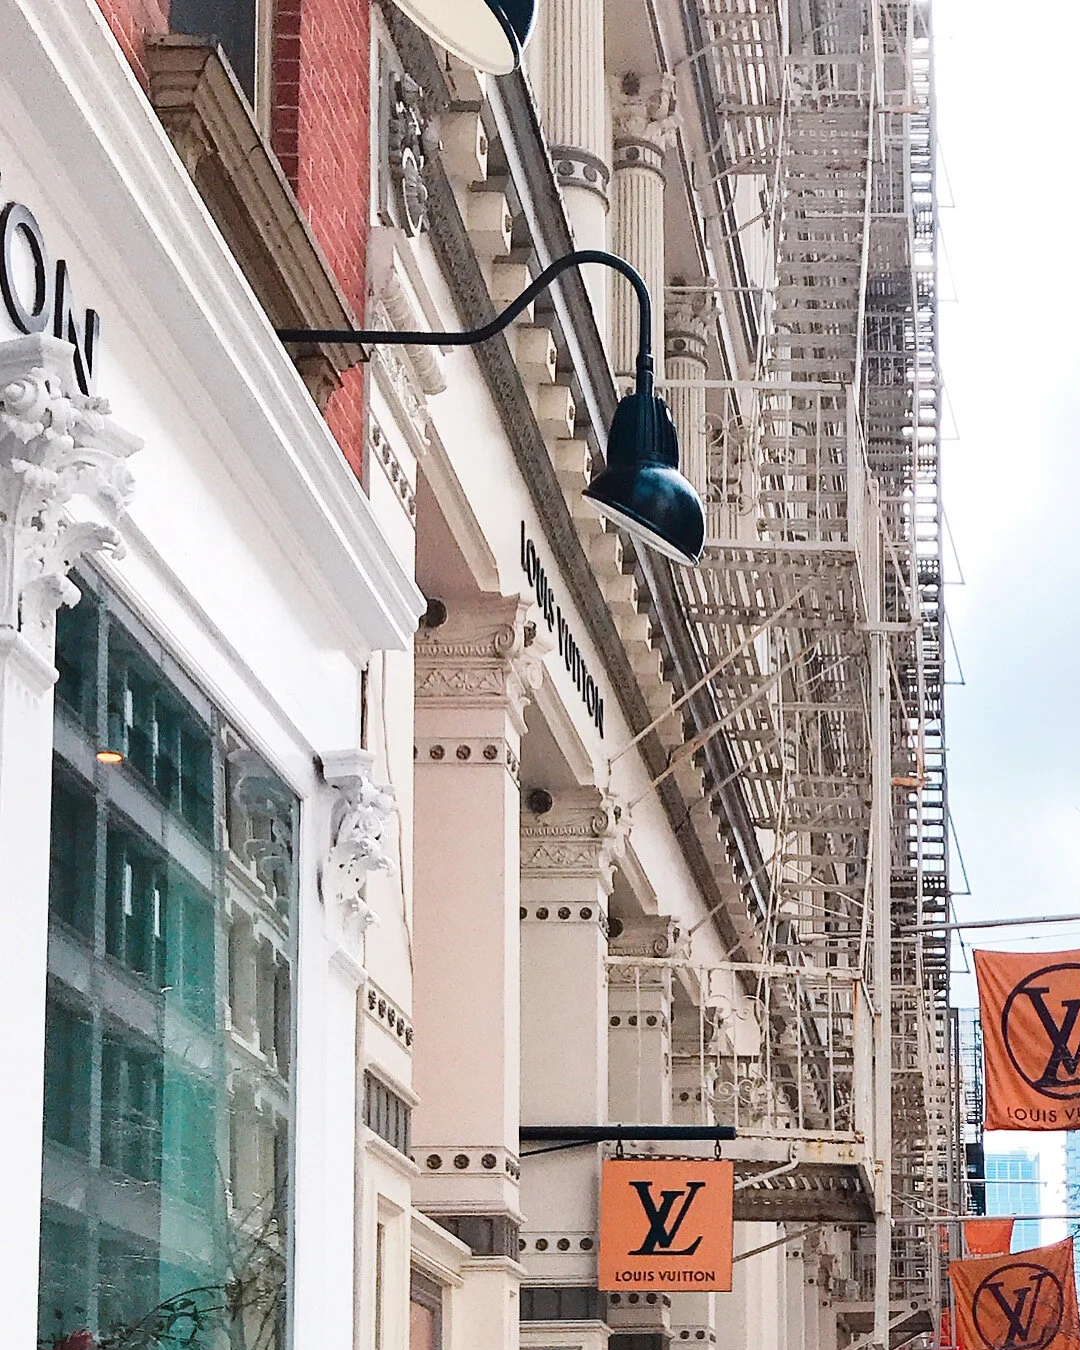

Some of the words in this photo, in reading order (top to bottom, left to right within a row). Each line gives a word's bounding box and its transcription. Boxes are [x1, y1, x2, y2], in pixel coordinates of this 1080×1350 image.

[521, 520, 555, 632] LOUIS
[556, 605, 604, 740] VUITTON
[1007, 1106, 1057, 1123] LOUIS
[615, 1271, 654, 1282] LOUIS
[658, 1271, 715, 1282] VUITTON
